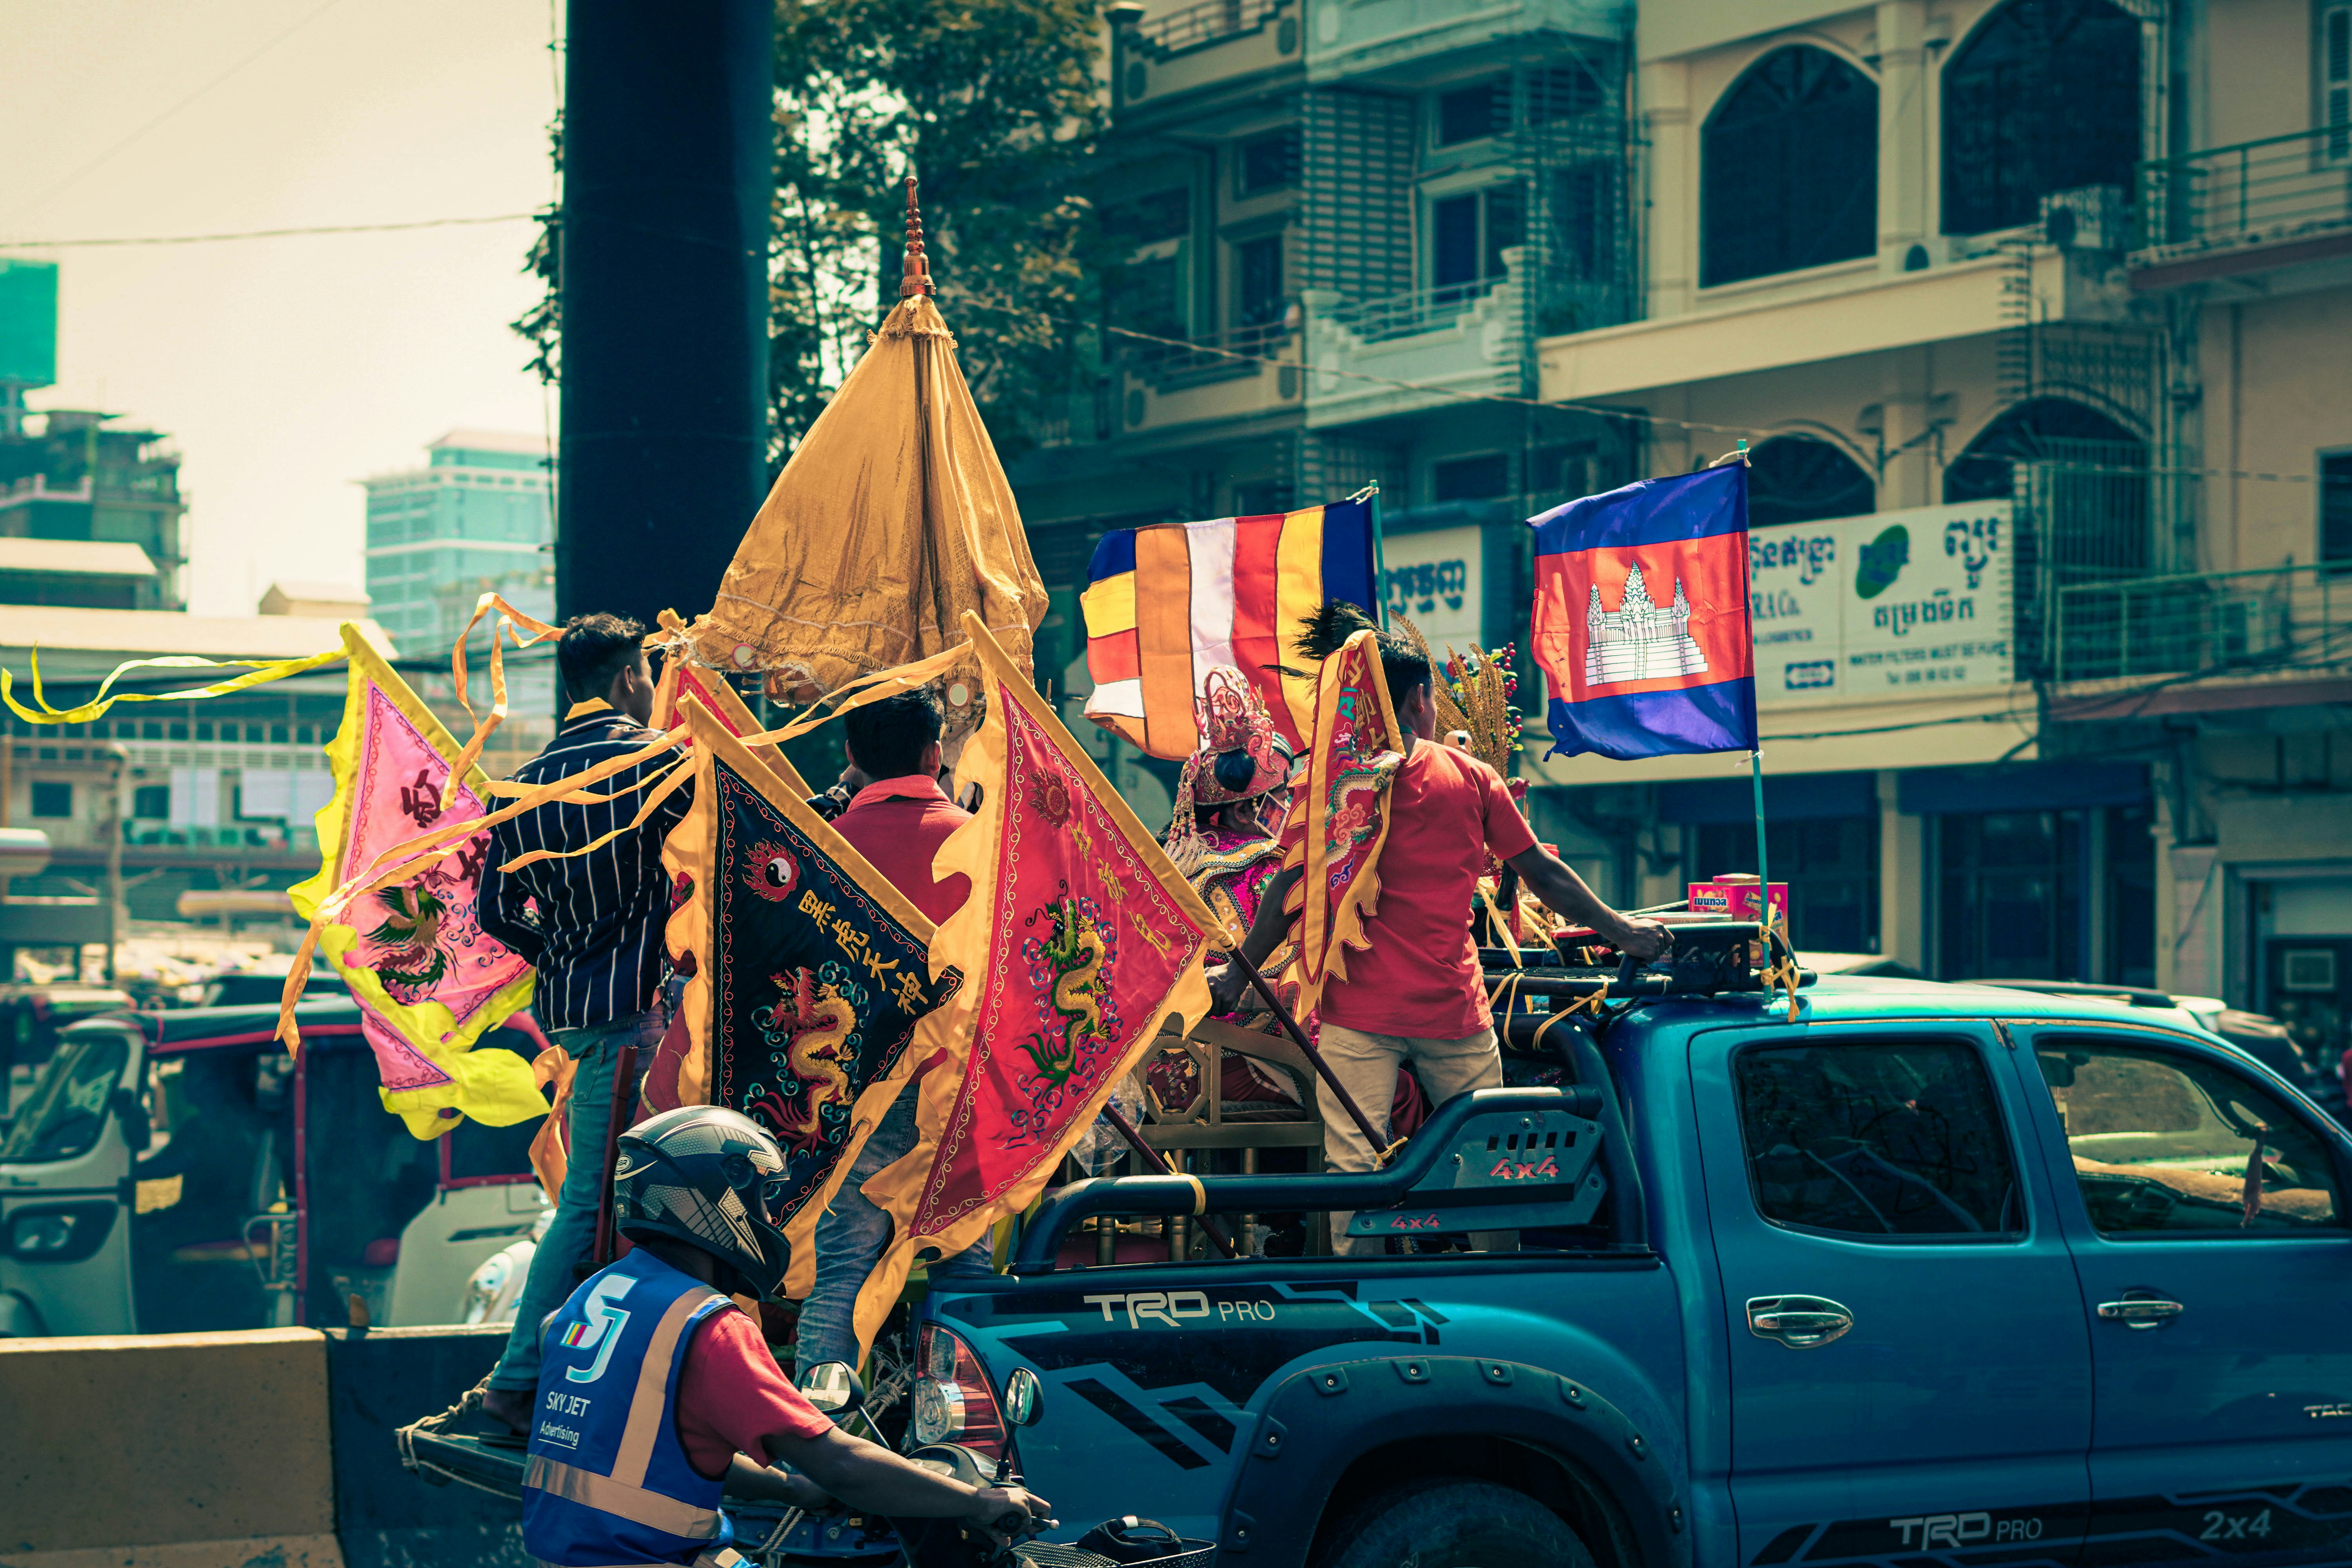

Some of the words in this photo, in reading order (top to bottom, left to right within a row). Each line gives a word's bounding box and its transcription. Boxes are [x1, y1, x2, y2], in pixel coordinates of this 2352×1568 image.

[1069, 820, 1172, 961] 紅孩兒
[1694, 897, 1727, 906] เมนทอส
[799, 889, 929, 1015] 黑虎天神
[1490, 1155, 1560, 1180] 4x4
[1390, 1213, 1441, 1230] 4x4
[1083, 1291, 1210, 1329] TRD
[1218, 1300, 1275, 1321] PRO
[546, 1391, 566, 1412] SKY
[564, 1397, 591, 1417] JET
[539, 1421, 580, 1446] Advertising
[1890, 1512, 1991, 1550] TRD
[1996, 1517, 2042, 1541] PRO
[2200, 1509, 2271, 1540] 2x4
